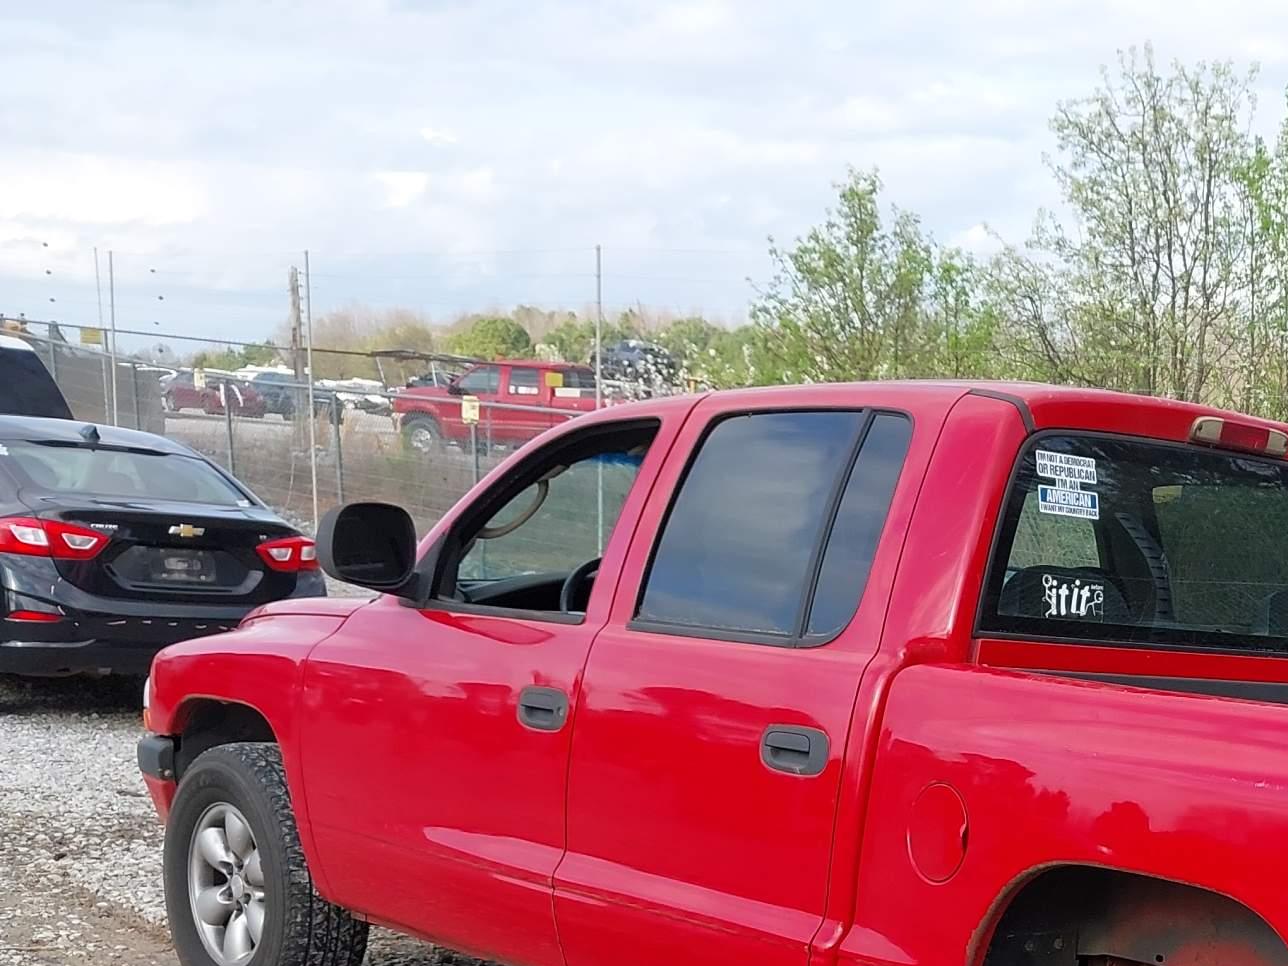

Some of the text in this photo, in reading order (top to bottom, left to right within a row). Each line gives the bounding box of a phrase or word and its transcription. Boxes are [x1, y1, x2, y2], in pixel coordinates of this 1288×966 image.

[1046, 452, 1058, 464] NOT
[1059, 454, 1064, 464] A
[1064, 456, 1094, 469] DEMOCRAT
[1038, 462, 1096, 481] OR REPUBLICAN
[1069, 480, 1079, 492] AN
[1046, 488, 1092, 508] AMERICAN
[1043, 503, 1057, 512] WANT
